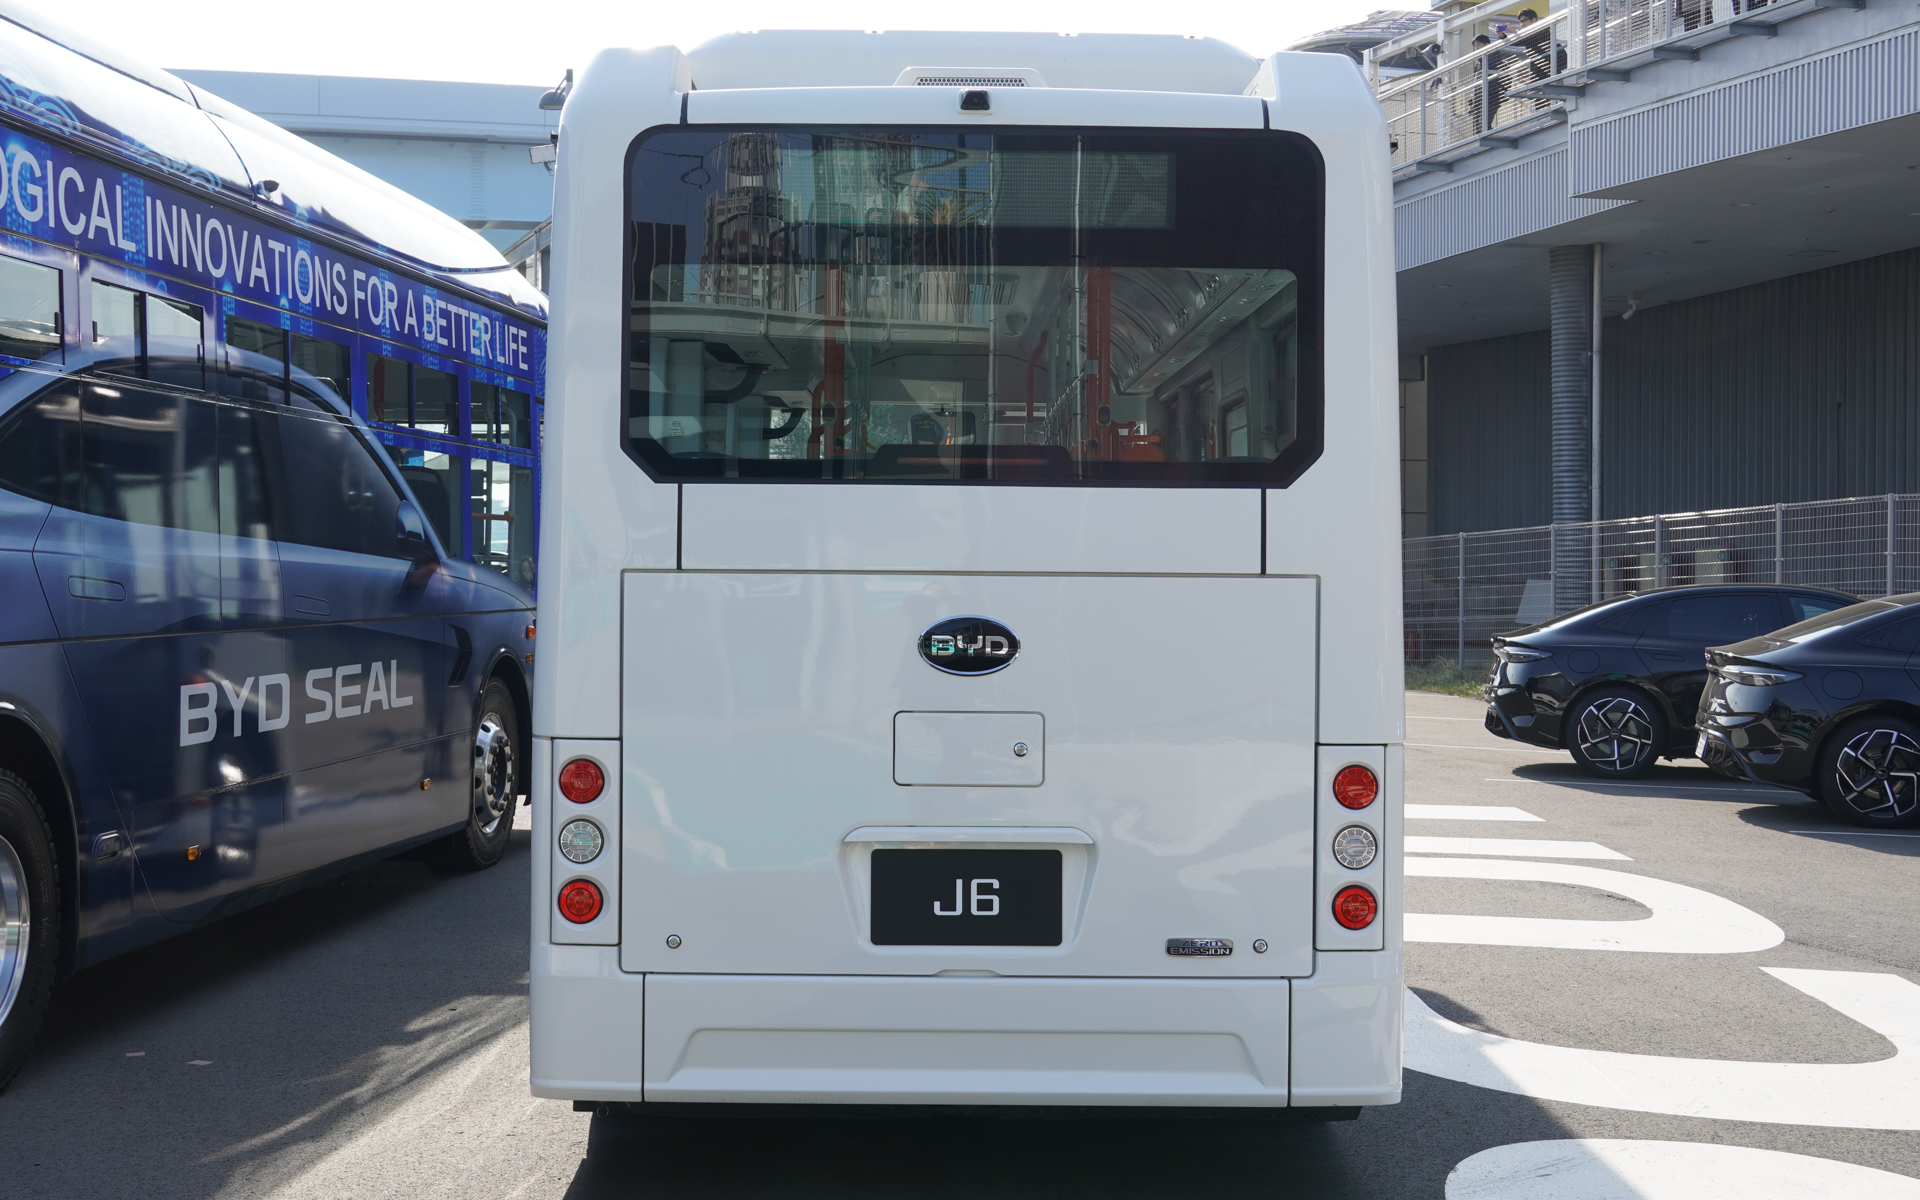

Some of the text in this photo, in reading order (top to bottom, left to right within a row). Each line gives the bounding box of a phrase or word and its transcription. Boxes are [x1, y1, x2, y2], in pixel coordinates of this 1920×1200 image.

[0, 147, 529, 371] GICAL INNOVATIONS FOR A BETTER LIFE
[931, 634, 1009, 657] BYD
[180, 659, 413, 747] BYD SEAL
[933, 878, 1000, 916] J6
[1170, 947, 1230, 955] EMISSION
[1181, 940, 1219, 948] ZERO
